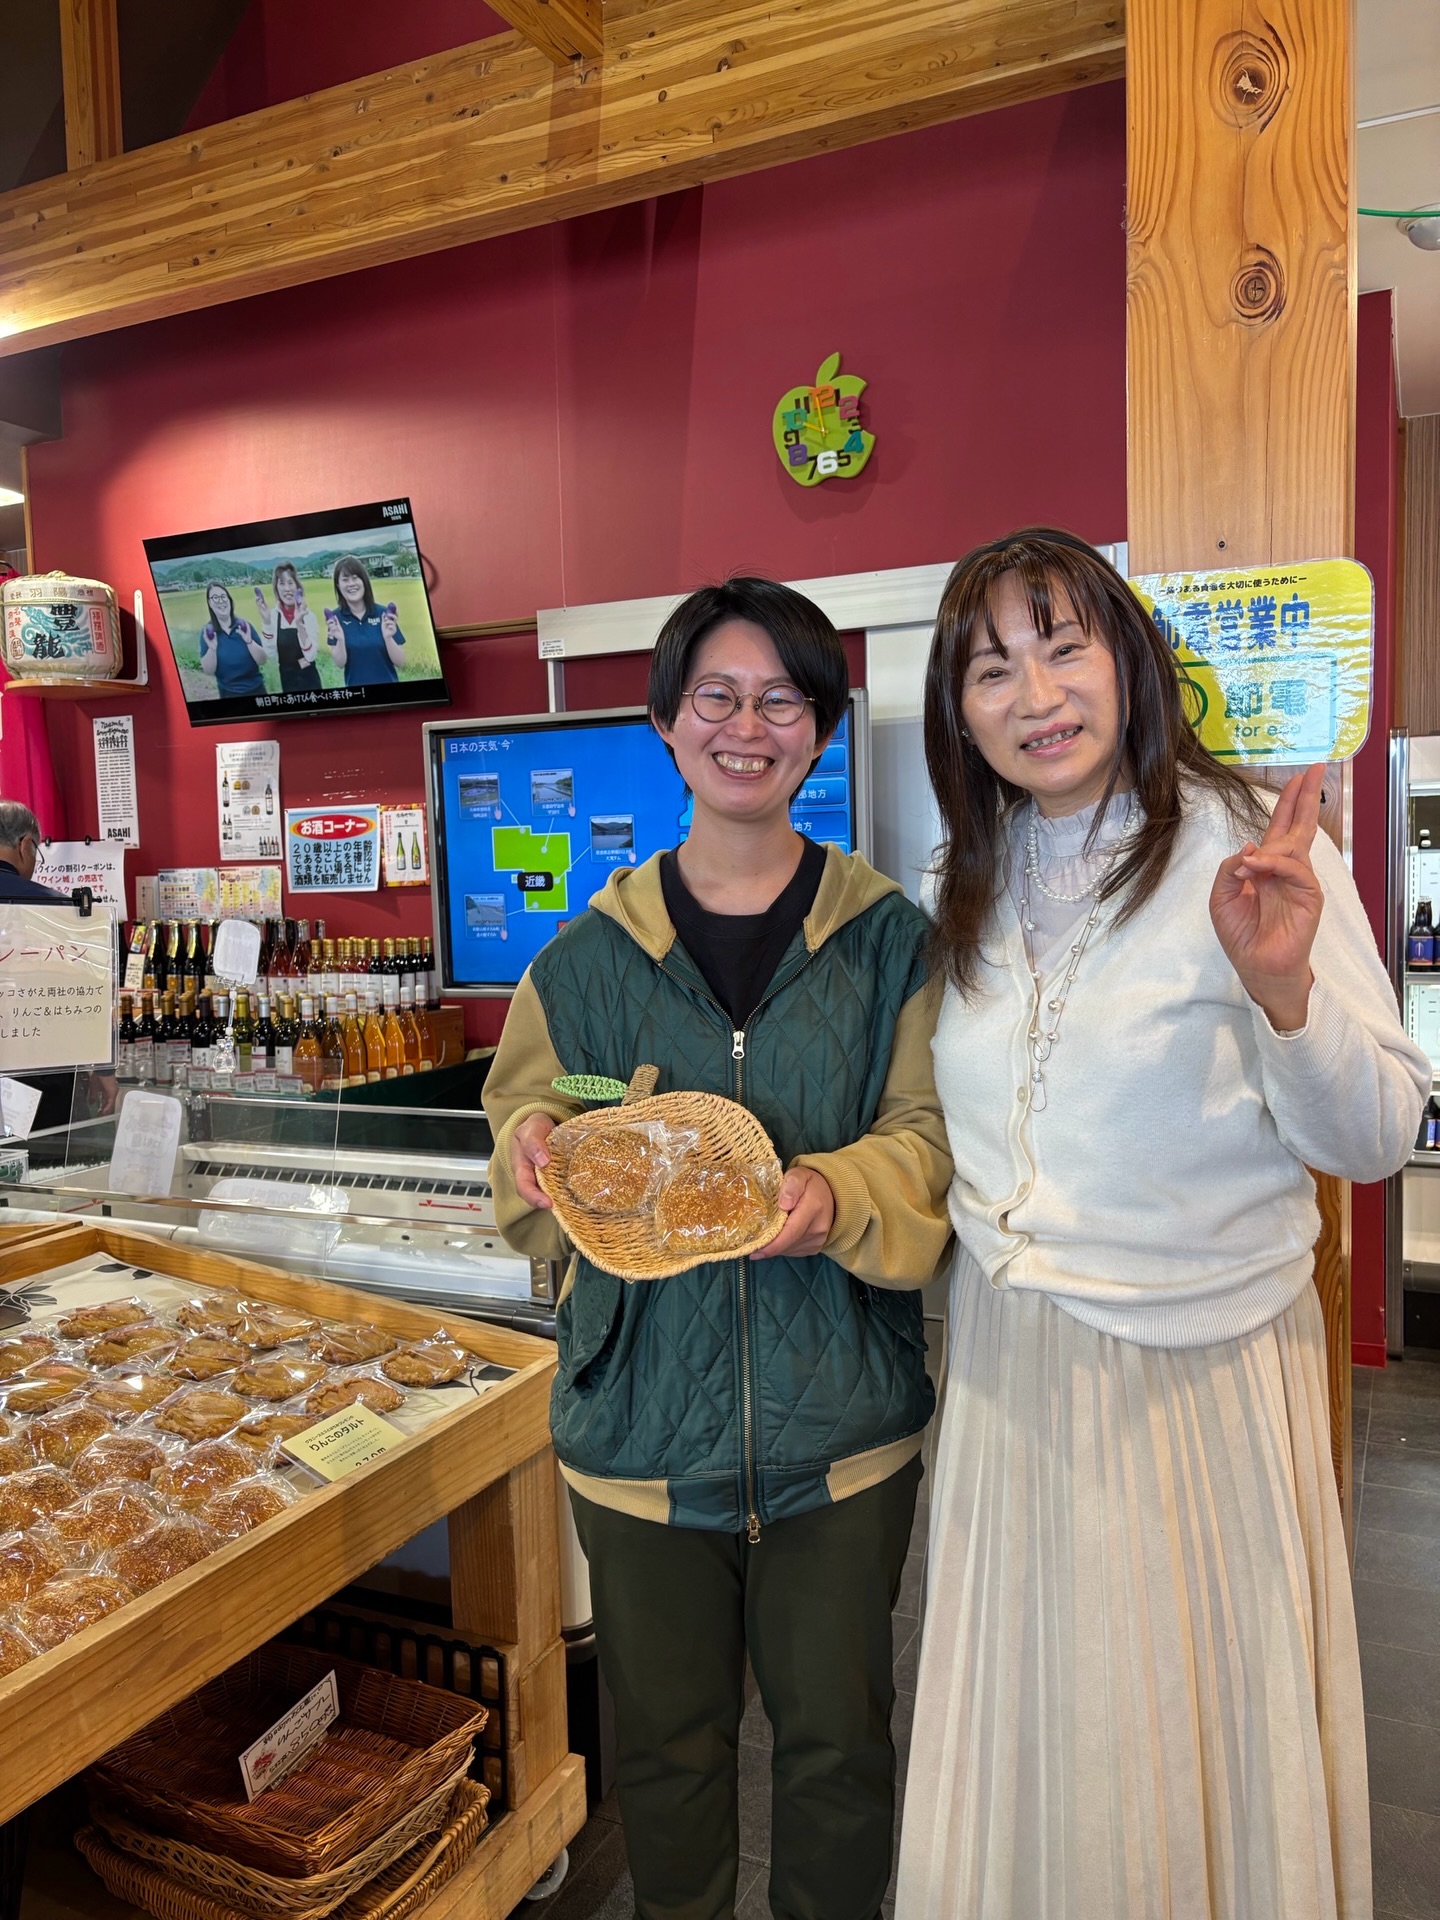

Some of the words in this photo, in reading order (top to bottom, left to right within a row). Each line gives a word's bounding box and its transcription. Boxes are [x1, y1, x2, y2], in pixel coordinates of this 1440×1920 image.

[808, 385, 836, 410] 12
[838, 395, 860, 420] 2
[844, 431, 865, 453] 4
[788, 444, 807, 466] 8
[817, 450, 838, 474] 6
[836, 449, 851, 467] 5
[382, 503, 408, 517] ASAHI
[1235, 723, 1261, 737] for
[107, 822, 131, 838] ASAHI
[301, 818, 368, 836] お酒コーナー
[790, 822, 812, 832] 地方
[293, 851, 372, 864] であることを確認
[293, 862, 371, 875] できない場合には
[294, 872, 371, 886] 酒類を販売しません
[525, 875, 546, 888] 近畿
[308, 1418, 365, 1452] りんごのタルト
